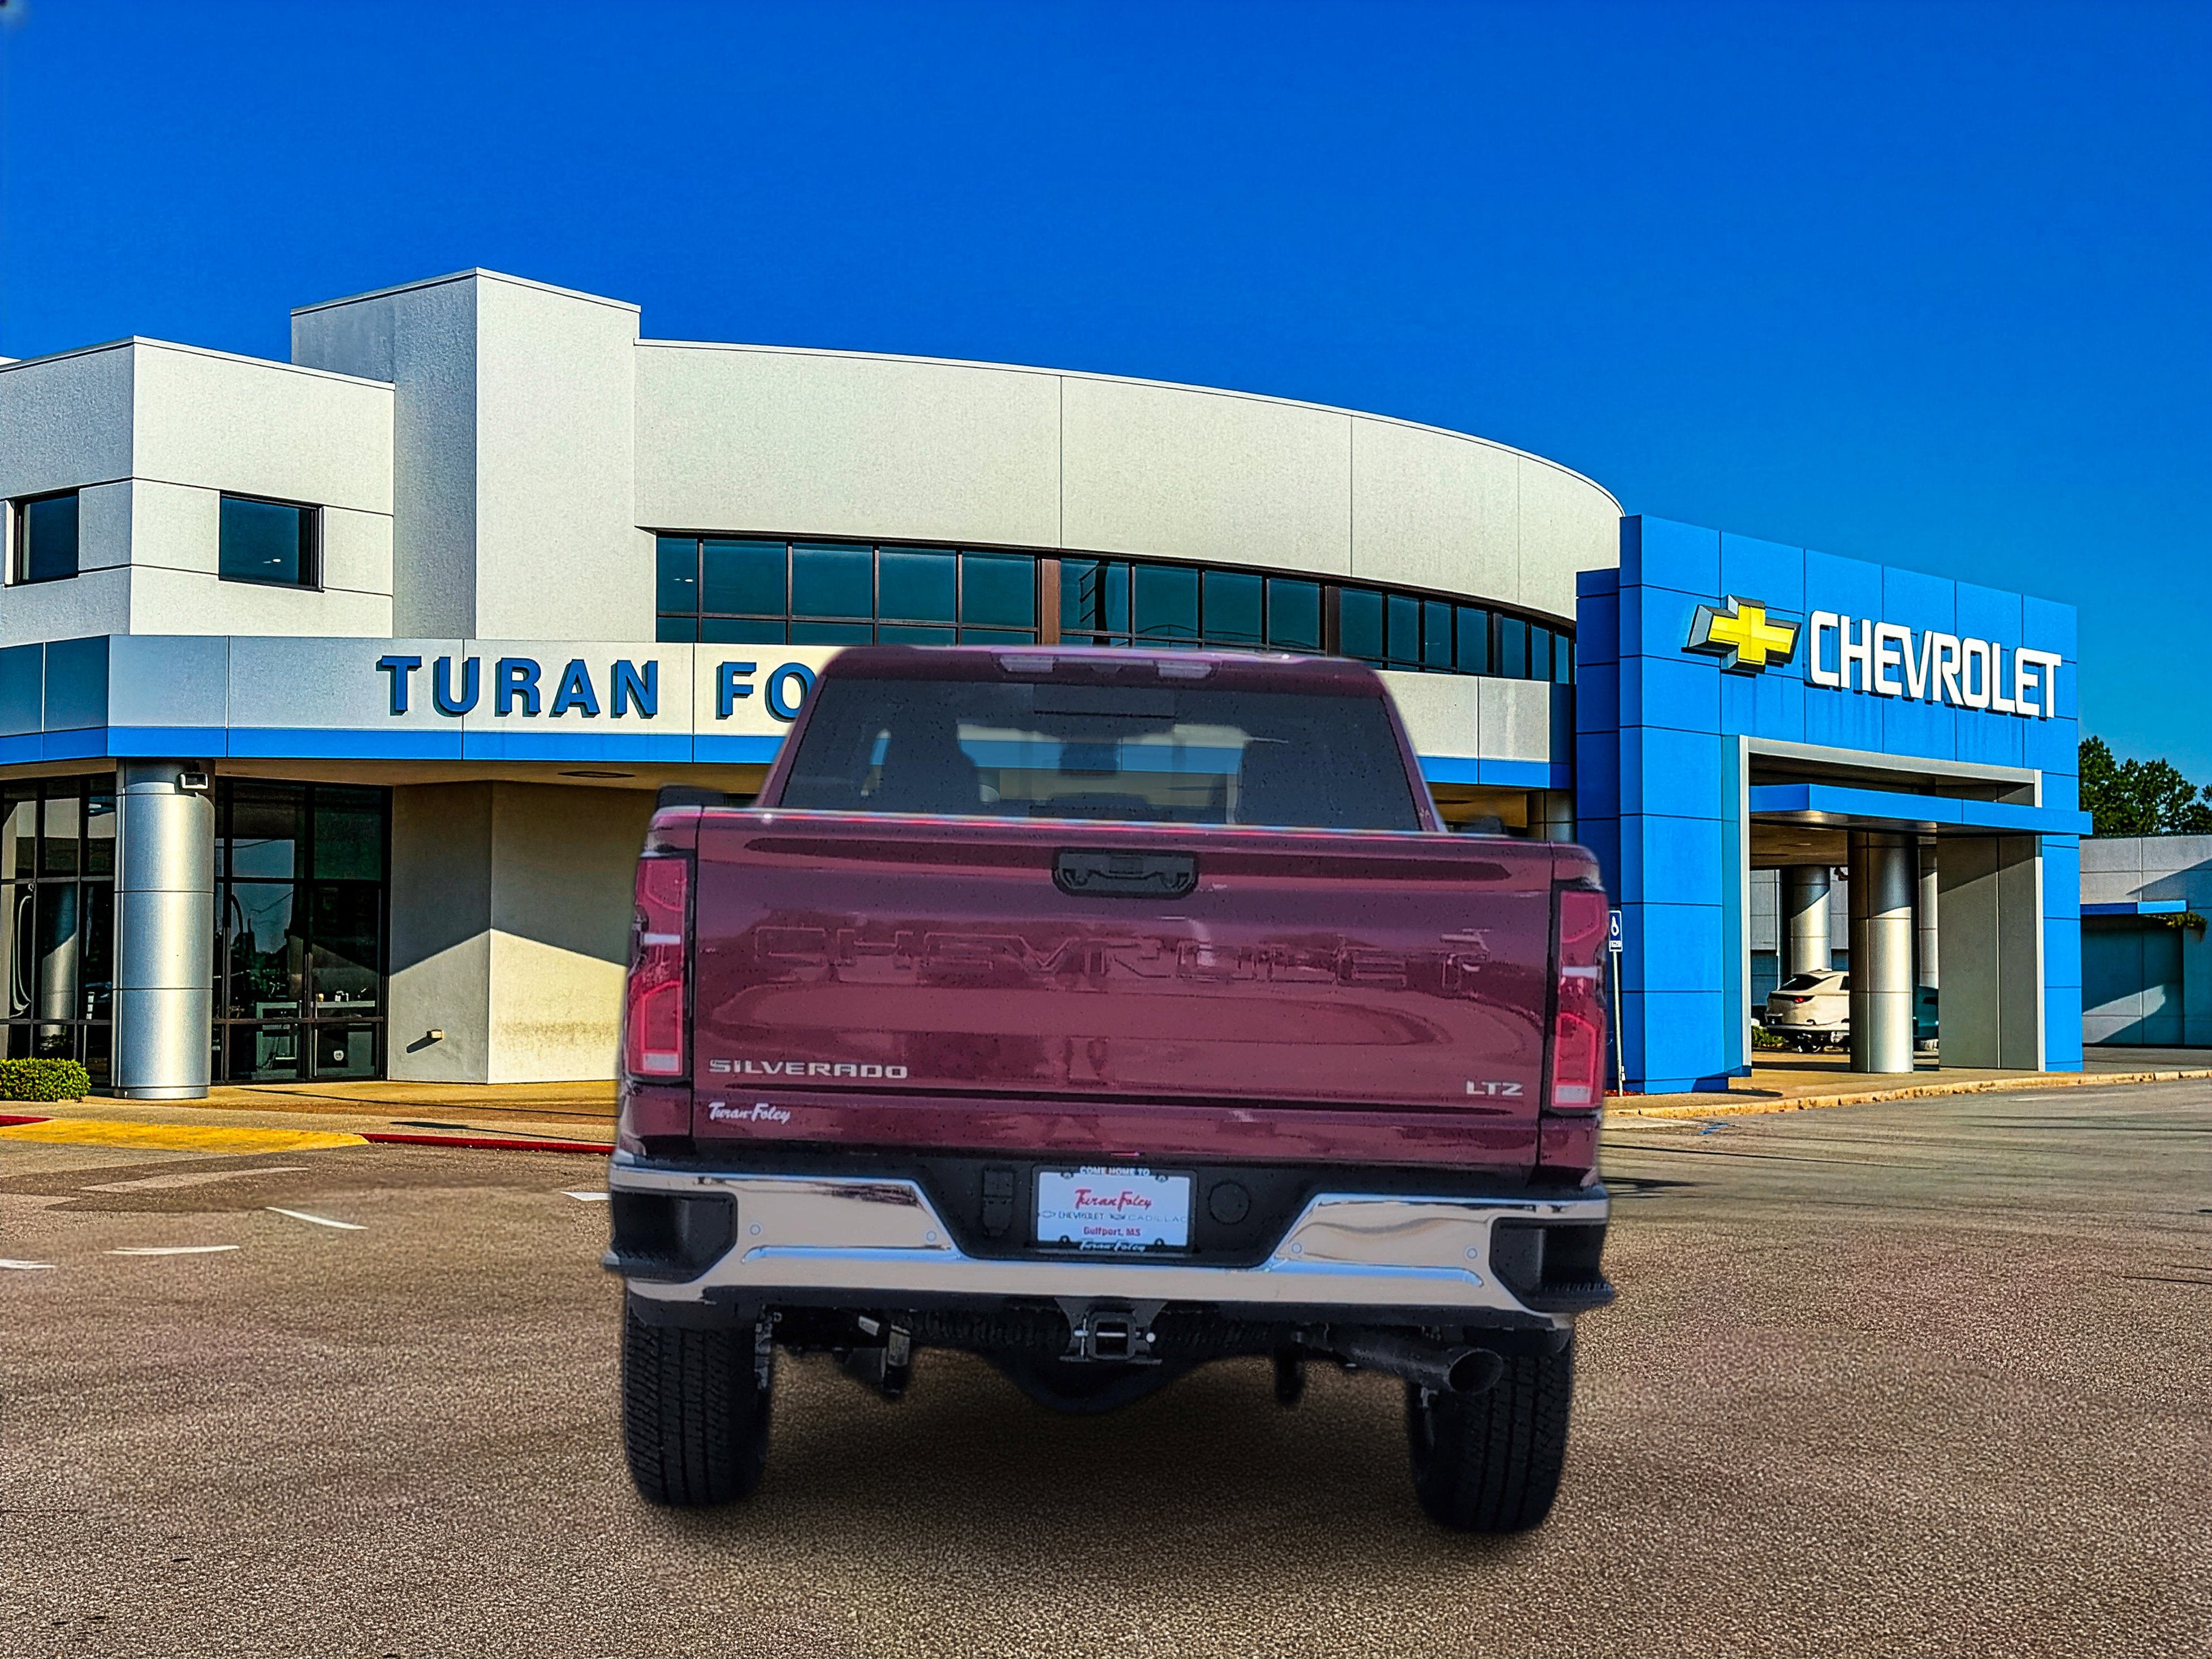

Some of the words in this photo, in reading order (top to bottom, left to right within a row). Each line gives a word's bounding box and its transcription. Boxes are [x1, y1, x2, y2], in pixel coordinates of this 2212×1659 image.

[1810, 610, 2062, 718] CHEVROLET
[375, 655, 659, 719] TURAN
[709, 1059, 908, 1079] SILVERADO
[1466, 1081, 1523, 1096] LTZ
[1079, 1166, 1107, 1174] COME
[1109, 1167, 1135, 1175] HOME
[1058, 1211, 1104, 1220] CHEVROLET
[1083, 1226, 1124, 1236] Gulfport,
[1126, 1227, 1141, 1236] MS
